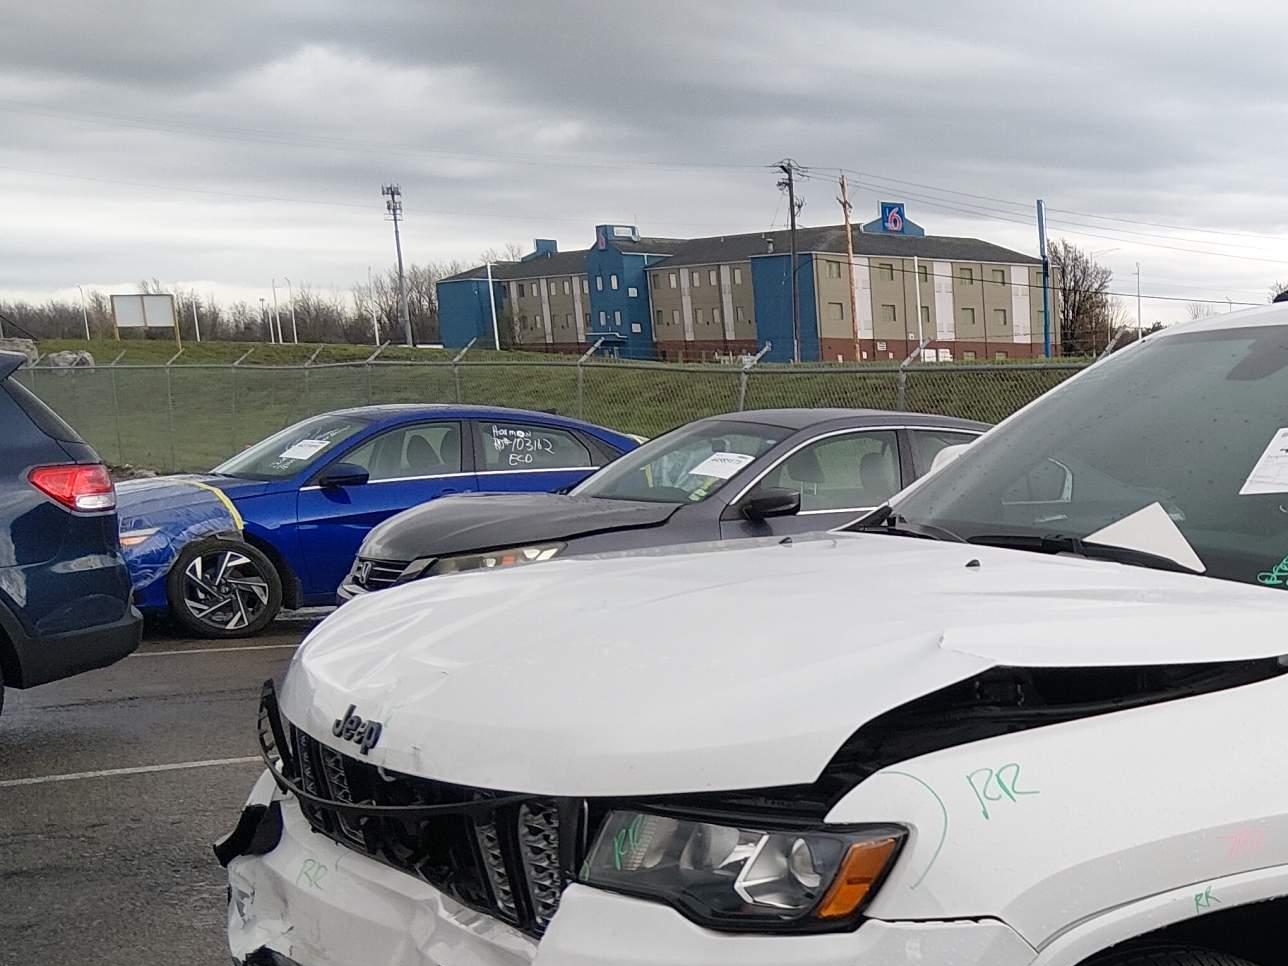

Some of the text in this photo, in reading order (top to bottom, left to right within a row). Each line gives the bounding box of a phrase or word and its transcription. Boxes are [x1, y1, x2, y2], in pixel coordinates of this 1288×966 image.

[888, 207, 902, 231] 6
[332, 704, 382, 756] Jeep
[966, 763, 1040, 820] RR
